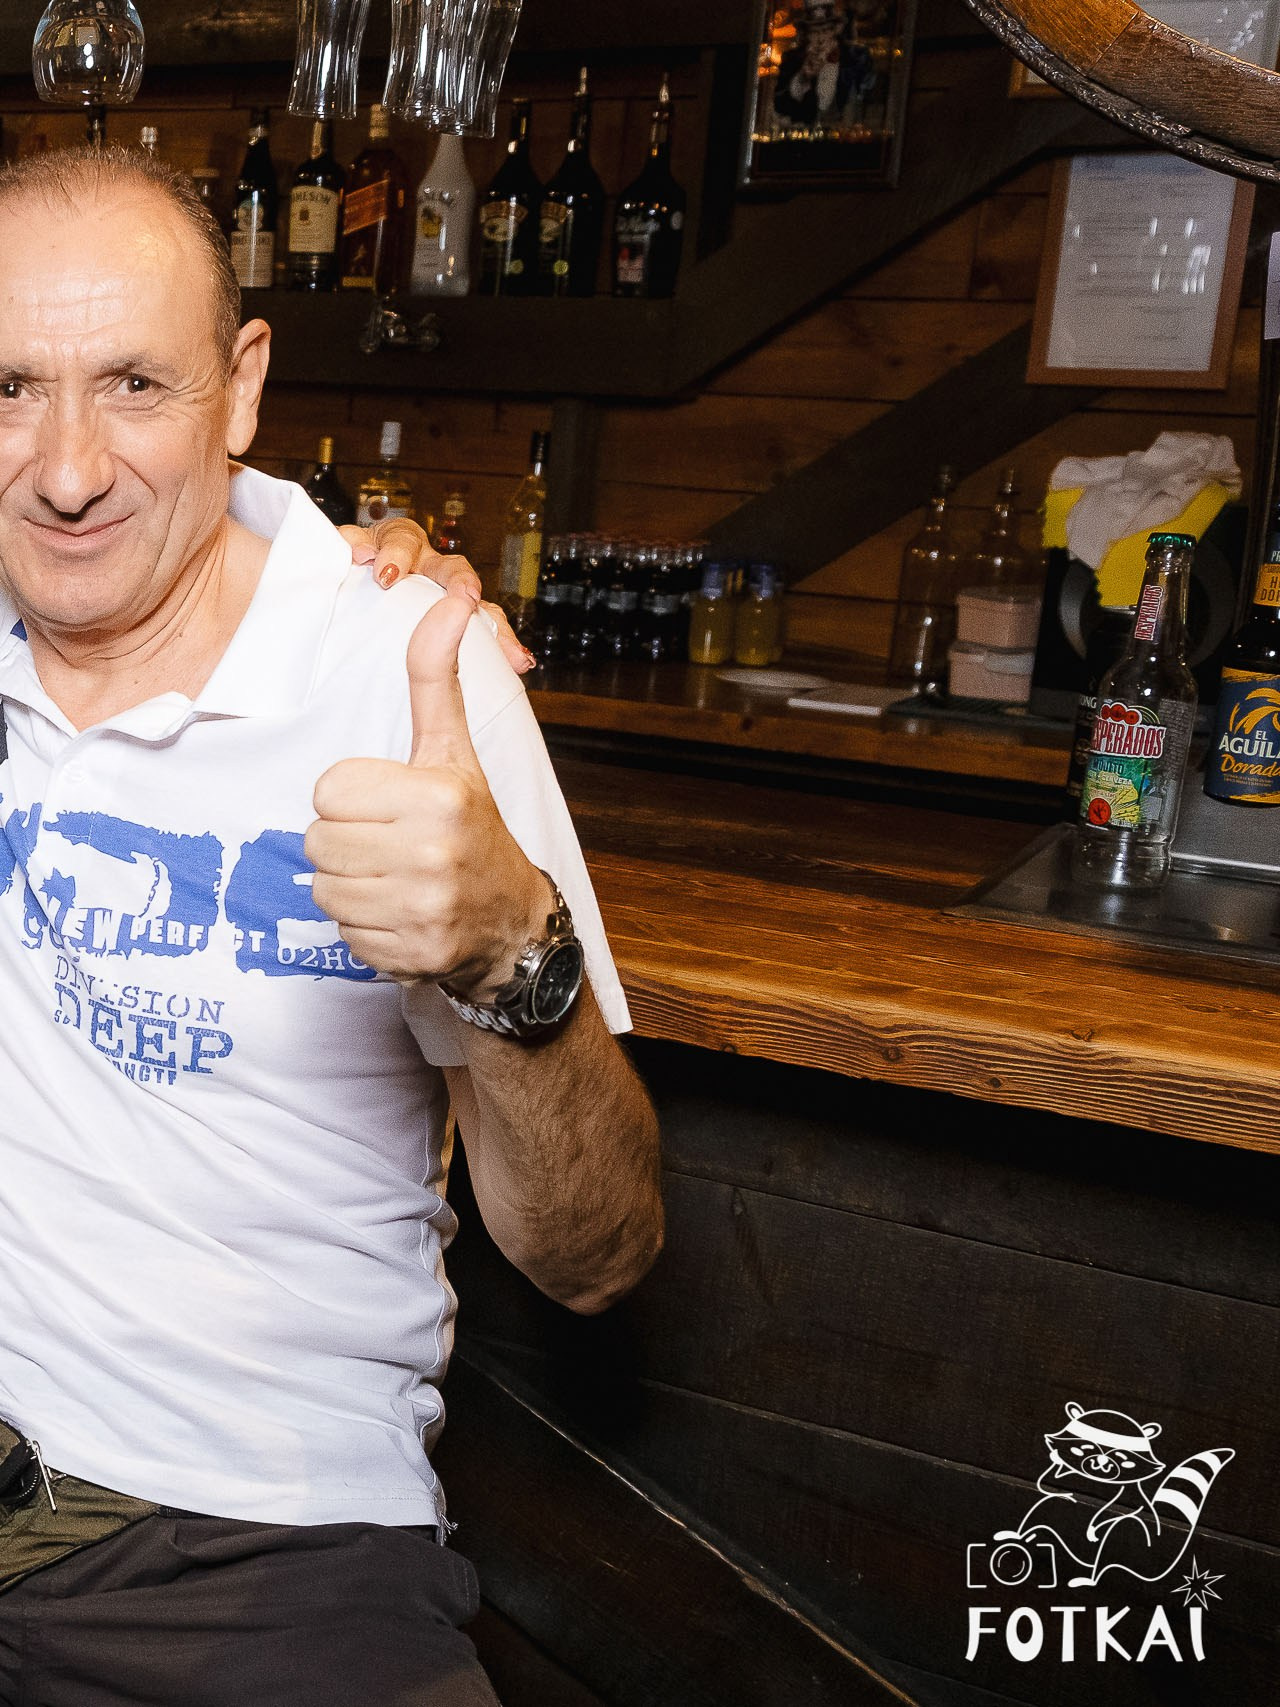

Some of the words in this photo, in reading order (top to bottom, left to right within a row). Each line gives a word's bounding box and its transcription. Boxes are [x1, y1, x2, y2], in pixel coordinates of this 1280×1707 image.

[1218, 732, 1280, 759] ÁGUIL
[1255, 730, 1268, 740] EL
[54, 982, 235, 1075] DEEP
